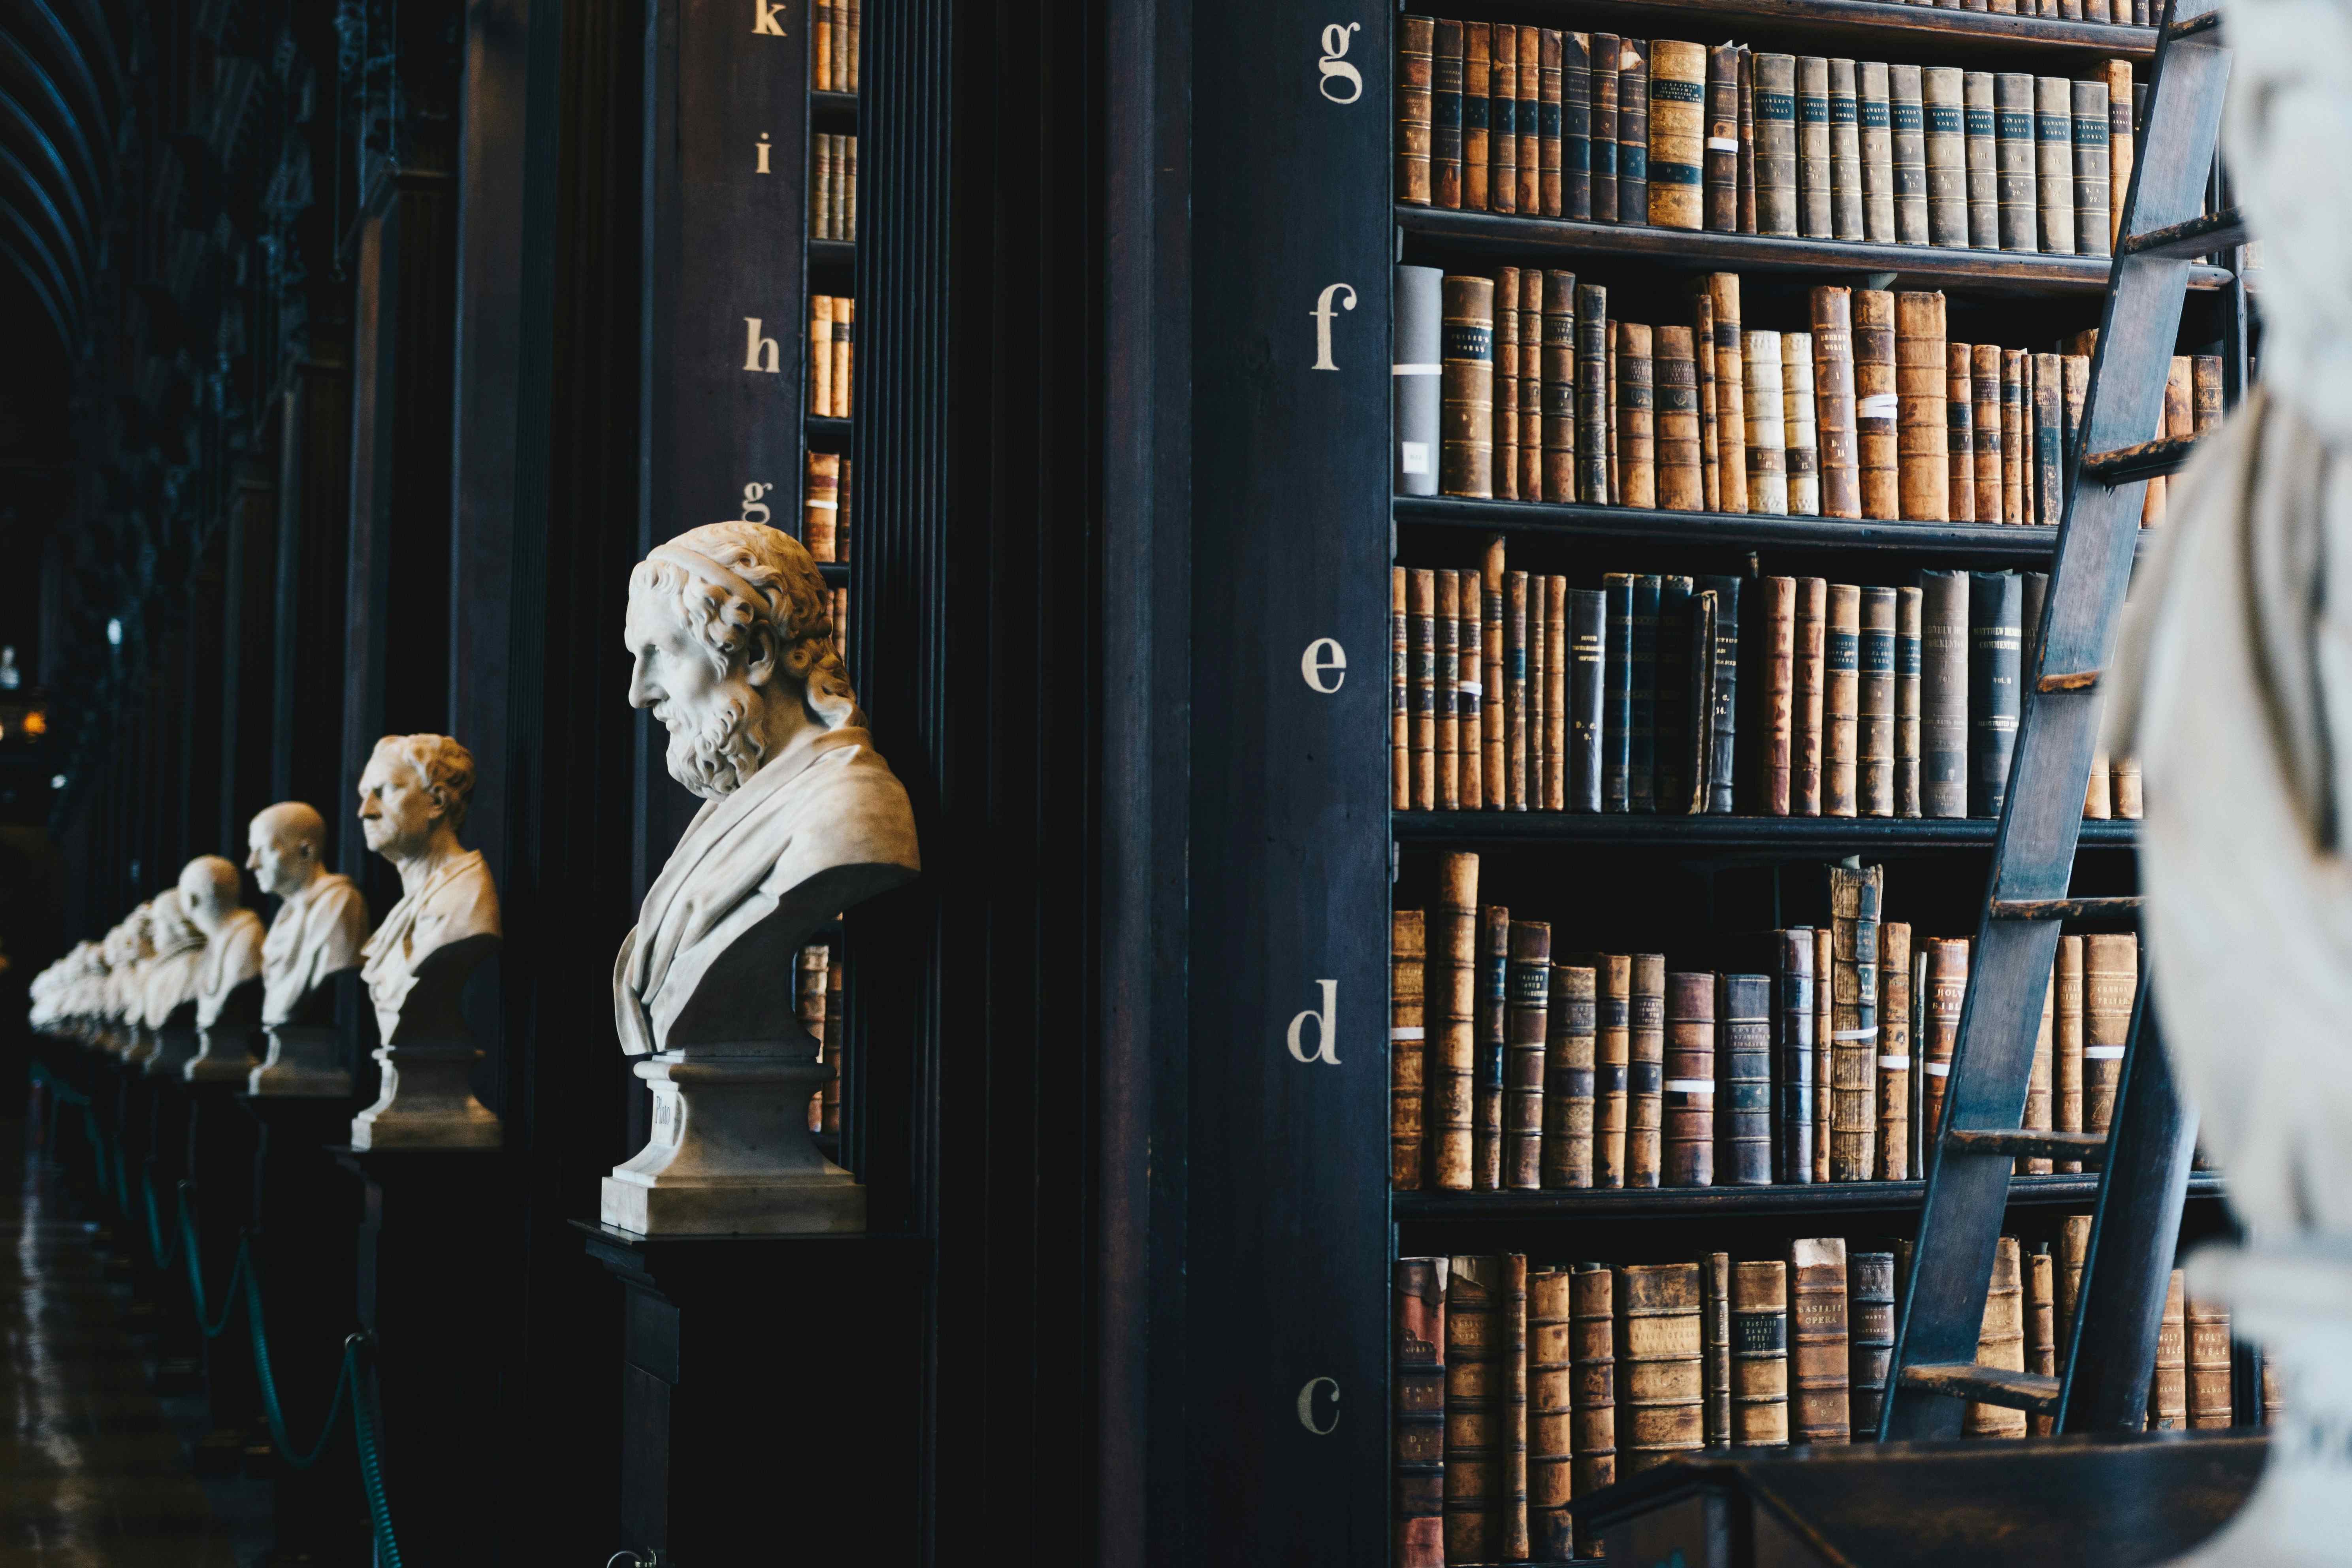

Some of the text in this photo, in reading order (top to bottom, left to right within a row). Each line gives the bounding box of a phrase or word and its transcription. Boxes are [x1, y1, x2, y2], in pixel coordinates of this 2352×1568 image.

[1318, 22, 1362, 104] g
[755, 132, 772, 174] i
[743, 317, 780, 373] h
[1309, 283, 1357, 371] f
[741, 482, 773, 524] g
[1974, 627, 2004, 636] MATTHEW
[1301, 638, 1346, 693] e
[1932, 1002, 1961, 1011] BIBL
[1938, 988, 1964, 998] HOLY
[1287, 979, 1342, 1064] d
[655, 1096, 670, 1125] Plato
[1798, 1304, 1842, 1313] BASILII
[1805, 1316, 1837, 1324] OPERA
[2156, 1346, 2181, 1354] BIBLE
[1298, 1377, 1339, 1434] c
